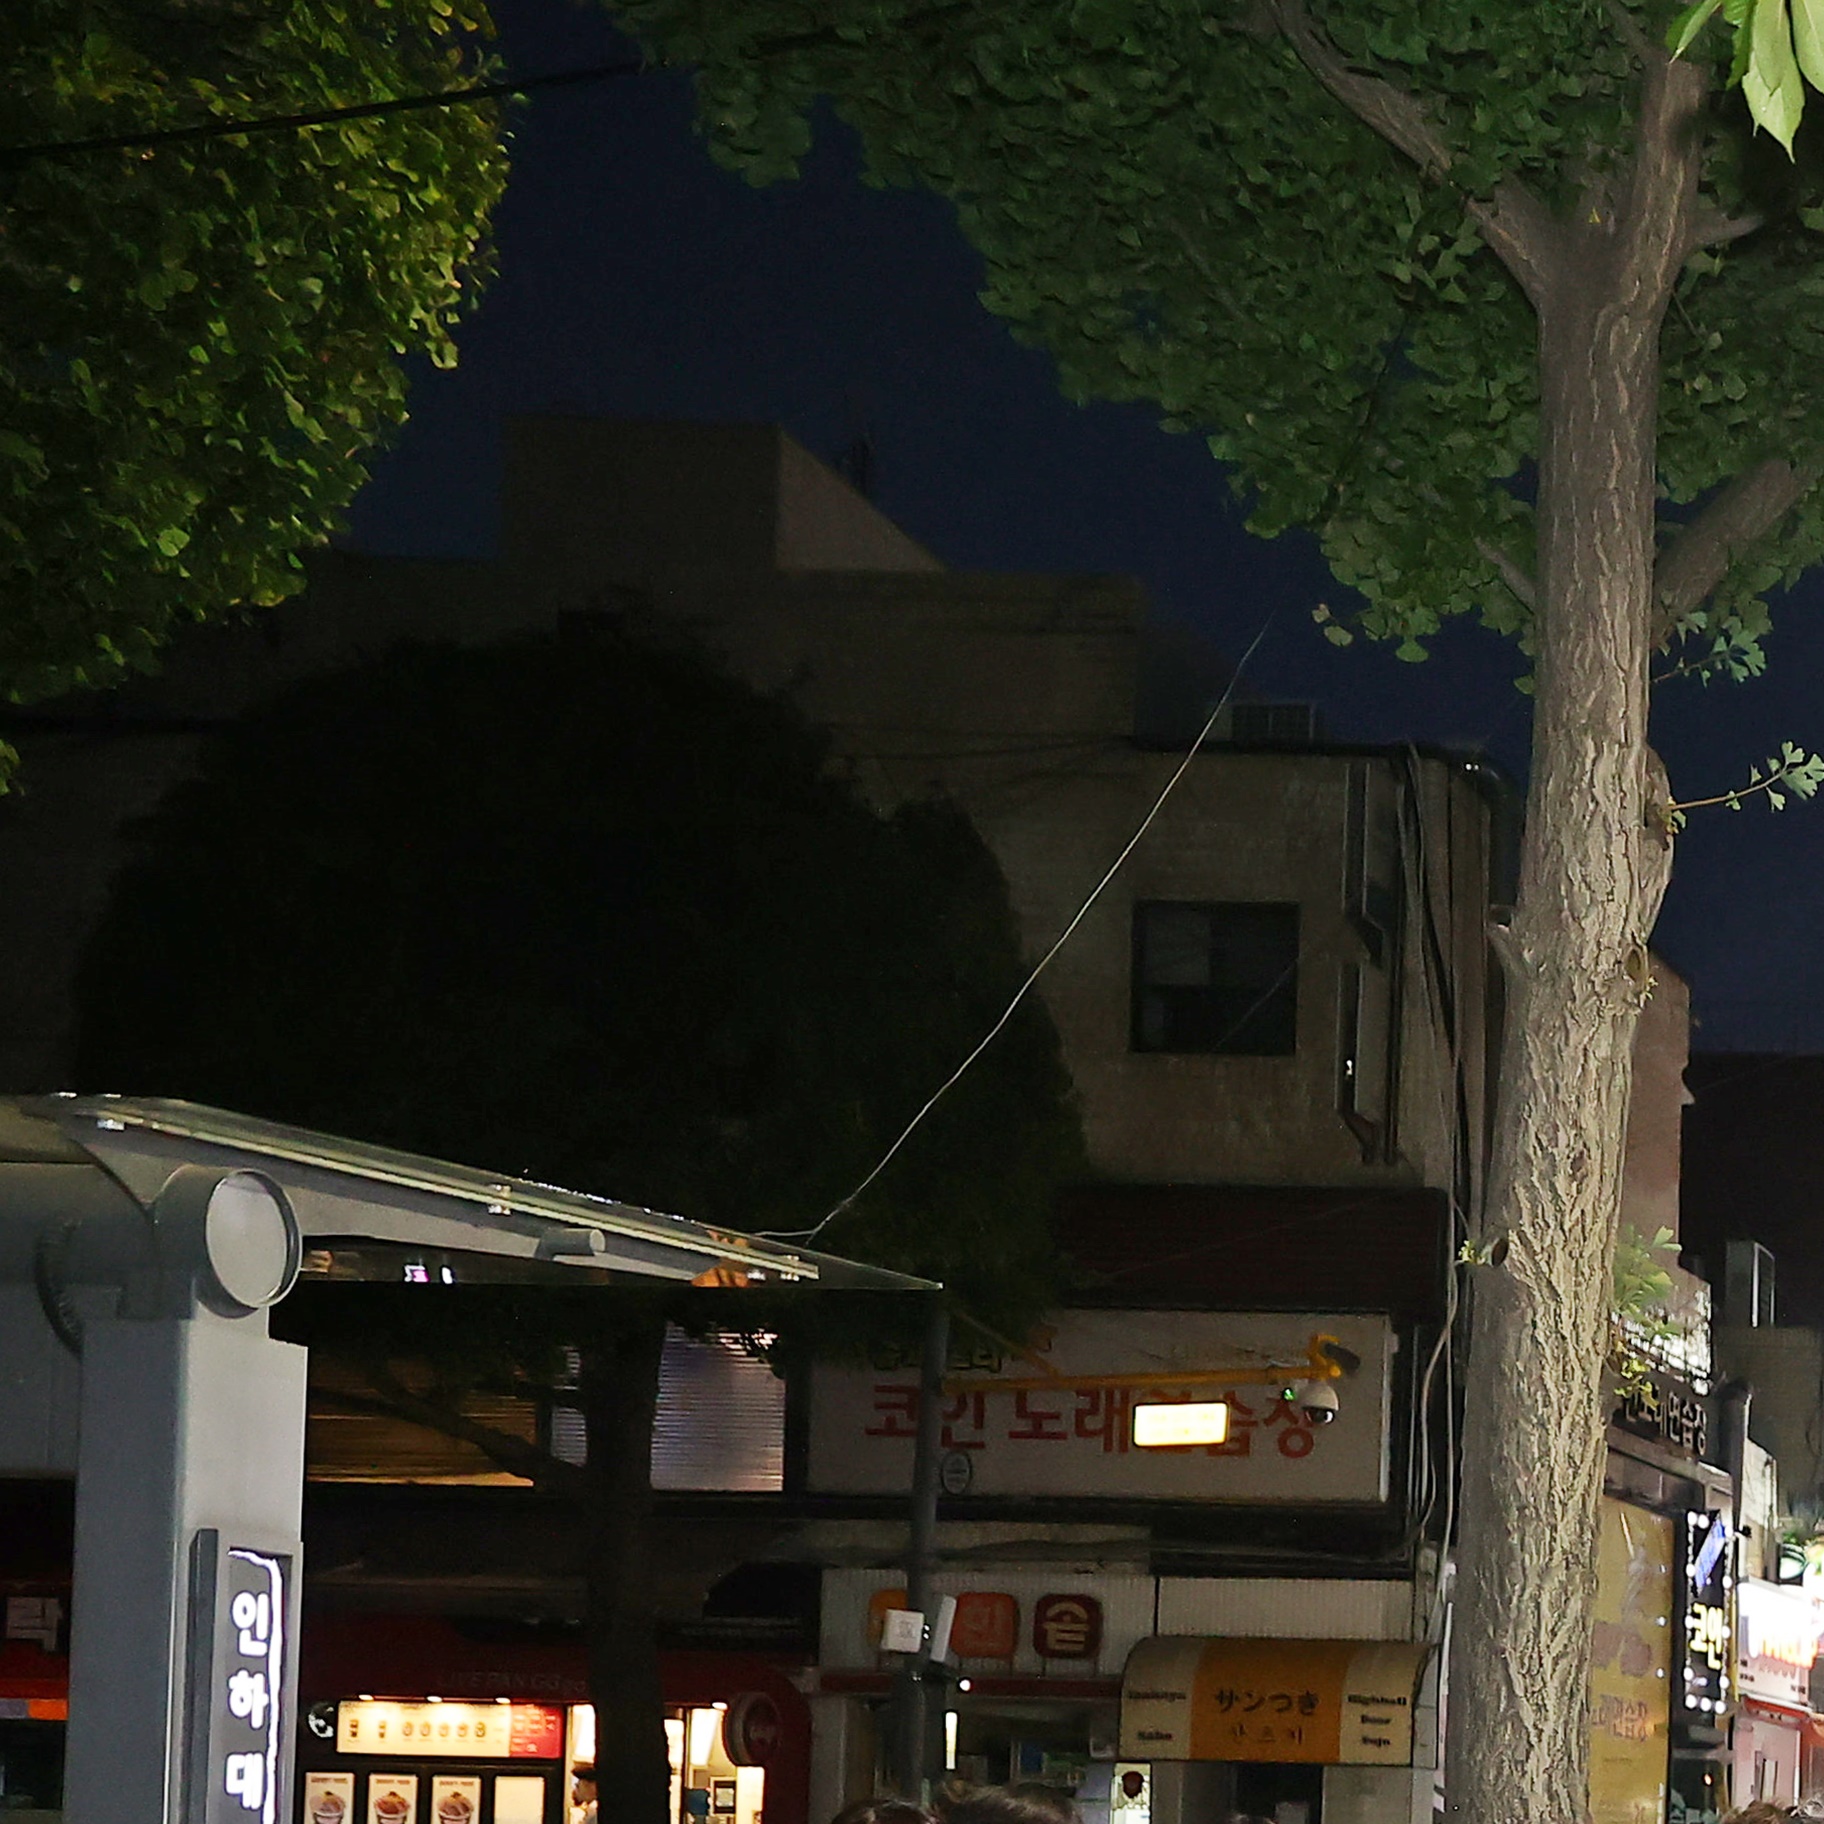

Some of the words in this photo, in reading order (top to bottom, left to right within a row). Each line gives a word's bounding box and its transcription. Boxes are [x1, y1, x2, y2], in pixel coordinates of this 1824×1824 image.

[865, 1384, 985, 1449] 코인
[1008, 1386, 1315, 1457] 노래습장
[1689, 1601, 1724, 1671] 코인
